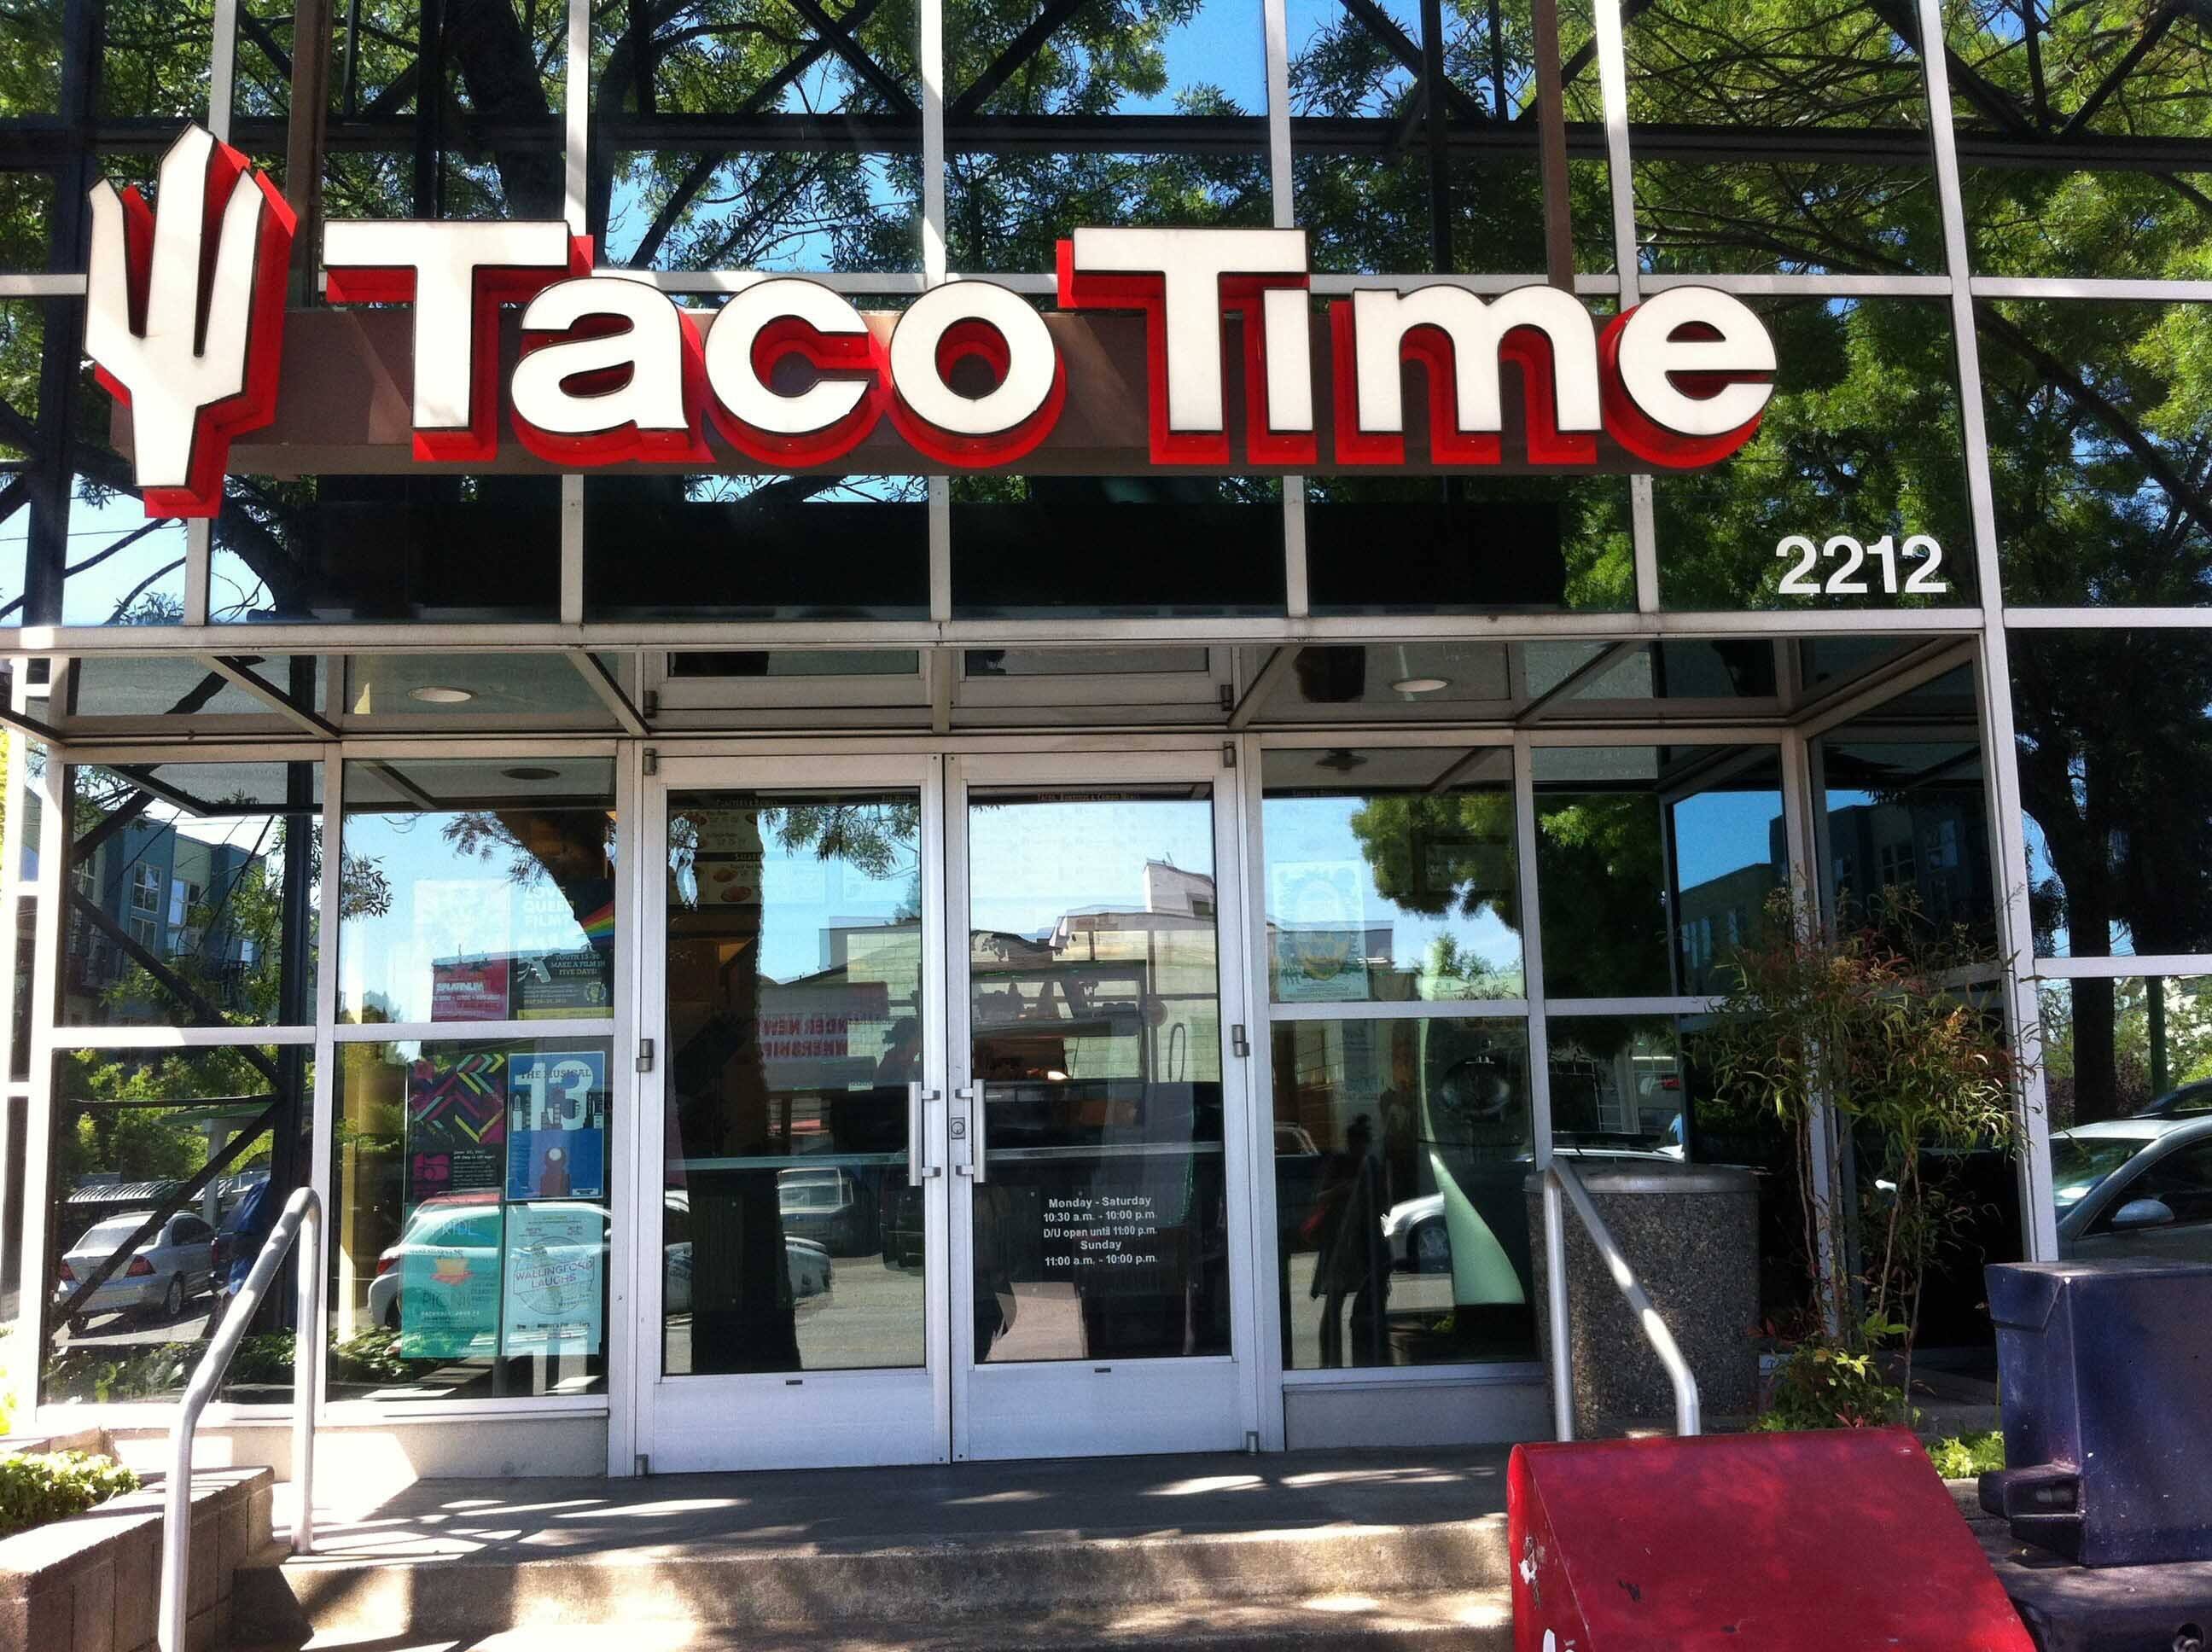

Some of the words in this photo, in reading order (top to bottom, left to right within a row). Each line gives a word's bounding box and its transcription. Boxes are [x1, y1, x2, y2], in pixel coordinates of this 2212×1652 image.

[323, 219, 1058, 439] Taco
[1072, 226, 1778, 439] Time
[1776, 535, 1947, 594] 2212
[521, 1070, 541, 1079] THE
[515, 1061, 593, 1131] 13
[1048, 1198, 1092, 1209] Monday
[1102, 1196, 1152, 1207] Saturday
[1043, 1213, 1070, 1223] 10:30
[1105, 1210, 1132, 1220] 10:00
[1043, 1229, 1061, 1238] D/U
[1063, 1230, 1088, 1239] open
[1090, 1226, 1110, 1236] until
[1113, 1225, 1135, 1236] 11:00
[1080, 1240, 1122, 1251] Sunday
[1045, 1256, 1071, 1266] 11:00
[1105, 1254, 1132, 1264] 10:00
